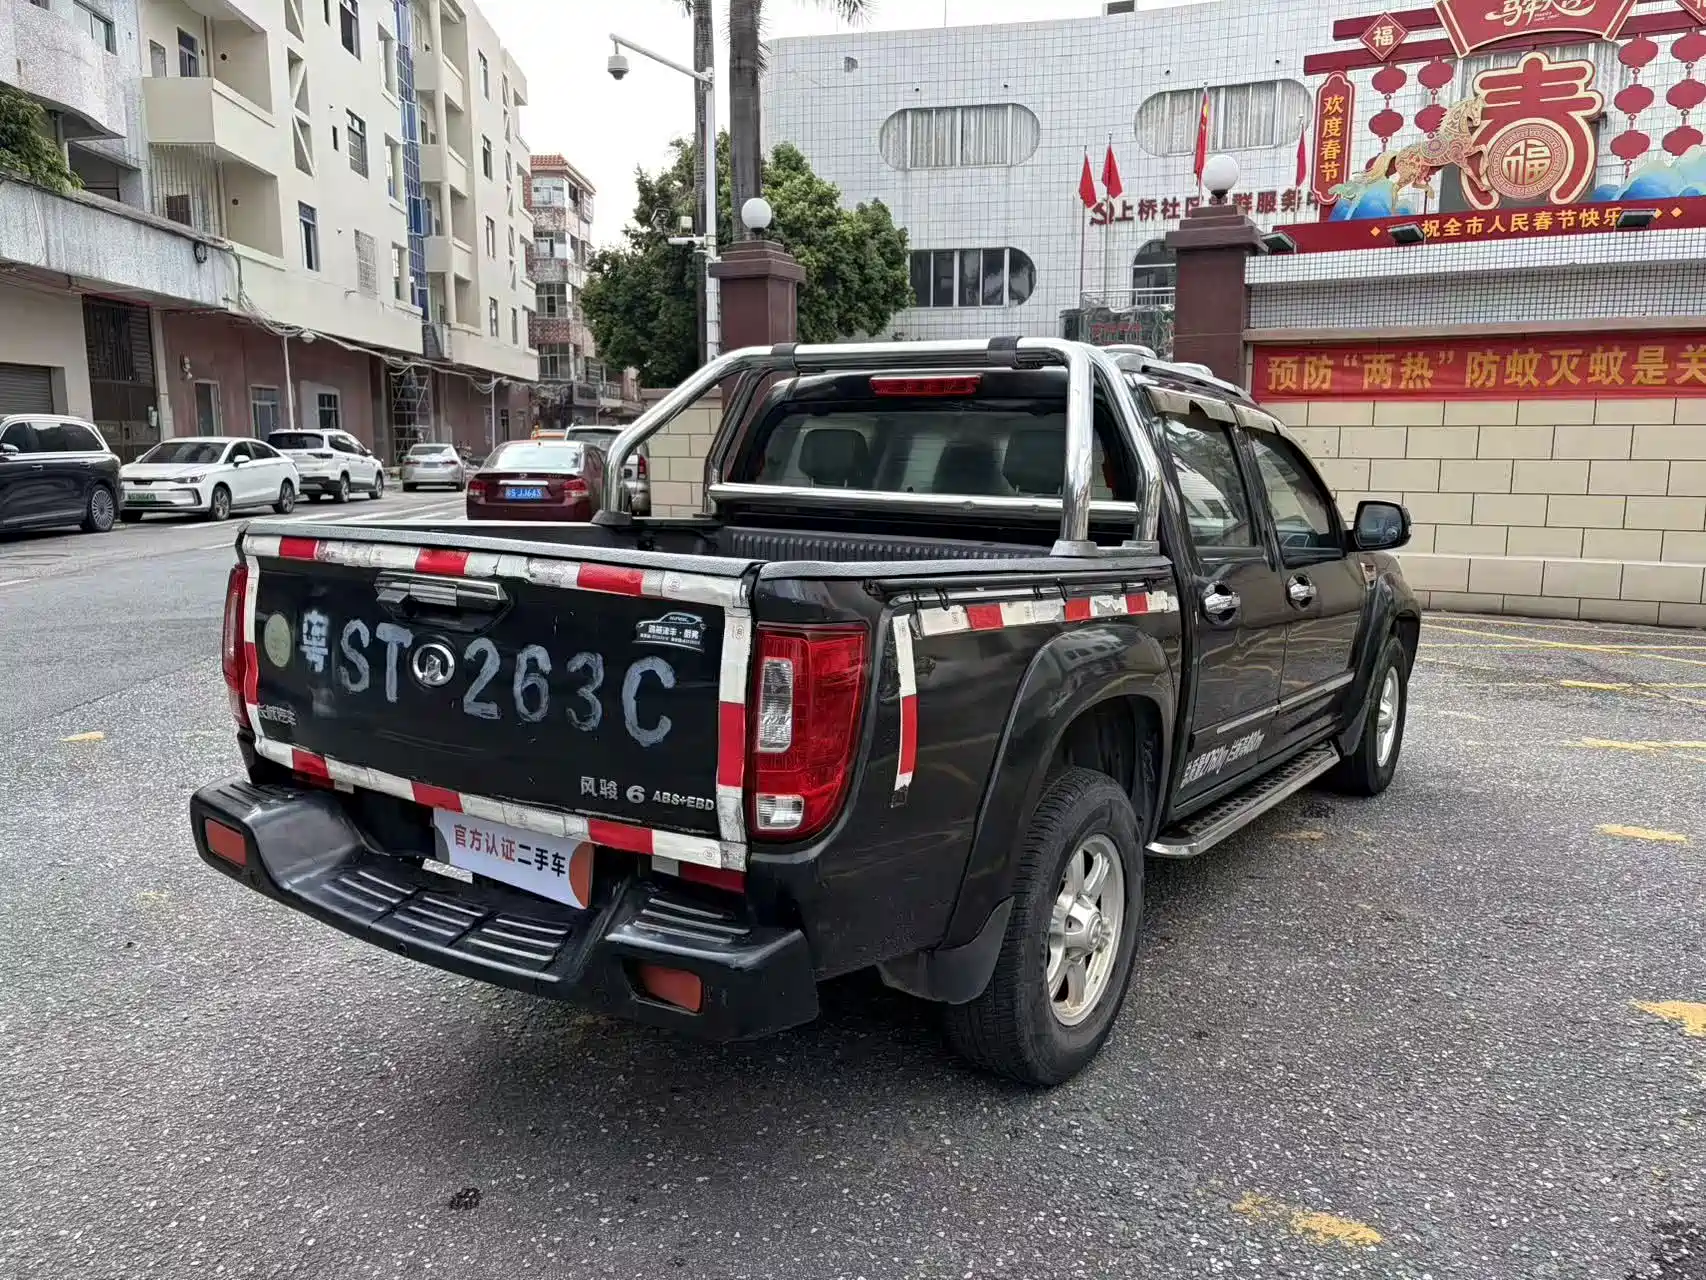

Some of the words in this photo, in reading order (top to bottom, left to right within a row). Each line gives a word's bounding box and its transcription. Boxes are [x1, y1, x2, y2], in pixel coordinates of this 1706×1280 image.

[1372, 24, 1395, 47] 福
[1319, 93, 1344, 184] 欢度春节
[1501, 138, 1552, 187] 福
[1421, 206, 1622, 239] 祝全市人民春节快乐
[580, 775, 619, 801] 风骏
[625, 784, 646, 804] 6
[652, 790, 715, 811] ABS+EBD
[453, 823, 567, 878] 官方认证二手车
